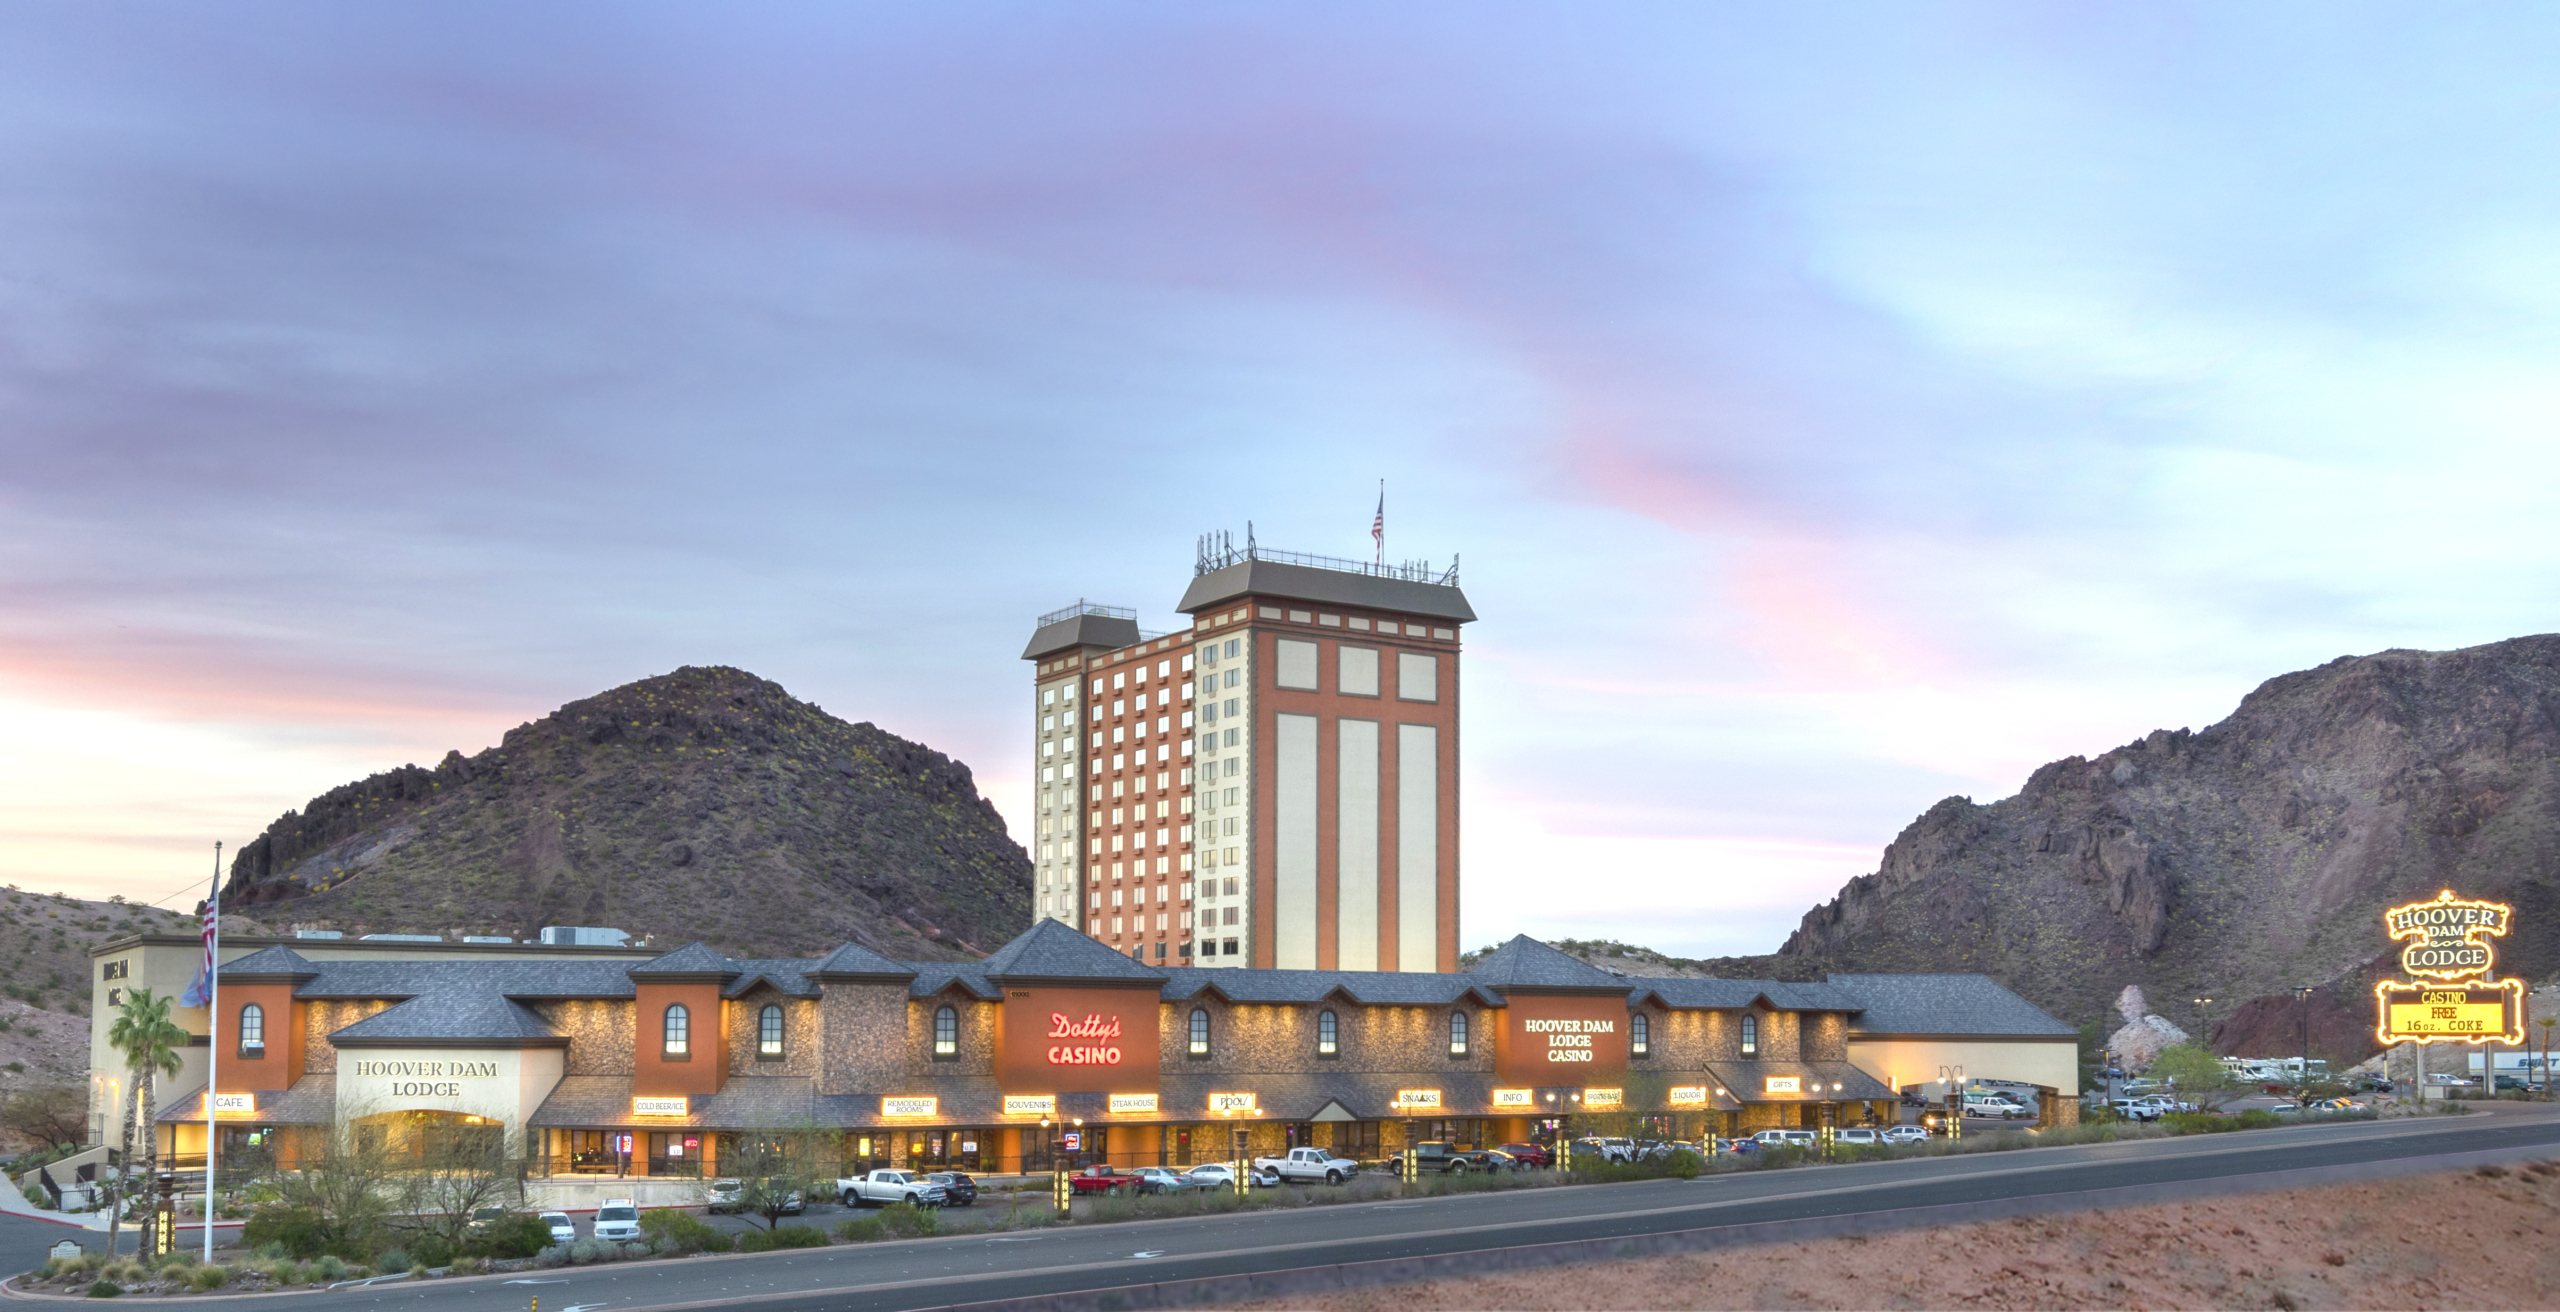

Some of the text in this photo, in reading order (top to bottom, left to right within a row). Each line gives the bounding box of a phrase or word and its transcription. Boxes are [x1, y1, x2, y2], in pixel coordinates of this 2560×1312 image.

[2397, 908, 2494, 928] HOOVER
[2428, 925, 2465, 937] DAM
[2409, 949, 2486, 966] LODGE
[2421, 992, 2466, 1004] CASINO
[2431, 1007, 2457, 1019] FREE
[1048, 1012, 1121, 1046] Dotty's
[1525, 1020, 1614, 1033] HOOVER DAM
[2449, 1020, 2483, 1031] COKE
[1549, 1035, 1592, 1047] LODGE
[1048, 1046, 1121, 1065] CASINO
[1548, 1049, 1593, 1062] CASINO
[2518, 1058, 2559, 1067] SWIT
[356, 1061, 499, 1077] HOOVER DAM
[392, 1082, 461, 1097] LODGE
[1674, 1091, 1701, 1099] LIQUOR
[216, 1098, 243, 1107] CAFE
[1111, 1099, 1155, 1108] STEAK HOUSE
[1503, 1093, 1523, 1102] INFO
[637, 1102, 684, 1111] COLD BEER/ICE
[1007, 1101, 1052, 1109] SOUVENIRS
